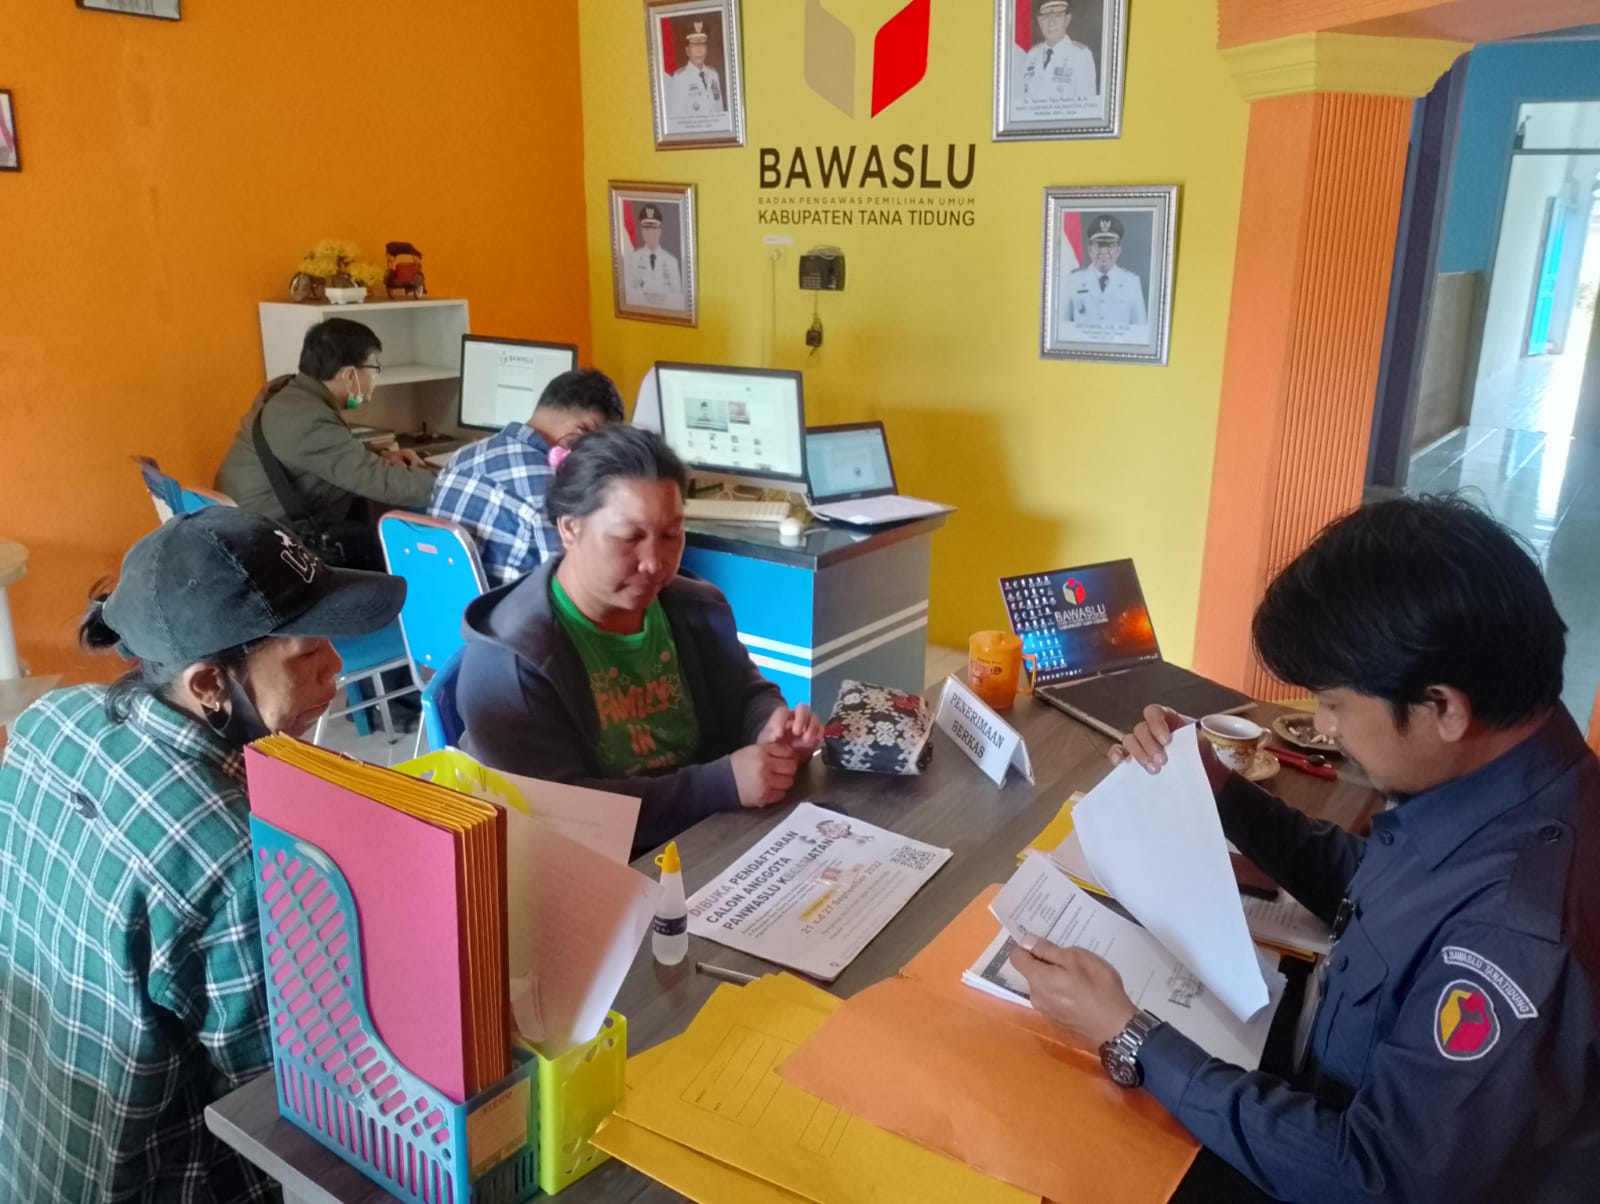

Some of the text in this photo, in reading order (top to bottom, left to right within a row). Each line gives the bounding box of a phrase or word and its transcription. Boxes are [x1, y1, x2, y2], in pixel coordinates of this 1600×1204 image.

[759, 143, 976, 189] BAWASLU
[758, 197, 975, 206] BADAN PENGAWAS PEMILIHAN UMUM
[758, 209, 976, 227] KABUPATEN TANA TIDUNG
[1054, 603, 1107, 623] BAWASLU
[950, 691, 1006, 750] PENERIMAAN
[951, 719, 986, 759] BERKAS
[689, 884, 736, 918] DIBUKA
[728, 830, 799, 886] PENDAFTARAN
[706, 893, 746, 924] CALON
[742, 856, 792, 896] ANGGOTA
[722, 883, 781, 931] PANWASLU
[1484, 964, 1505, 987] TANA
[1501, 980, 1530, 1013] TIDUNG
